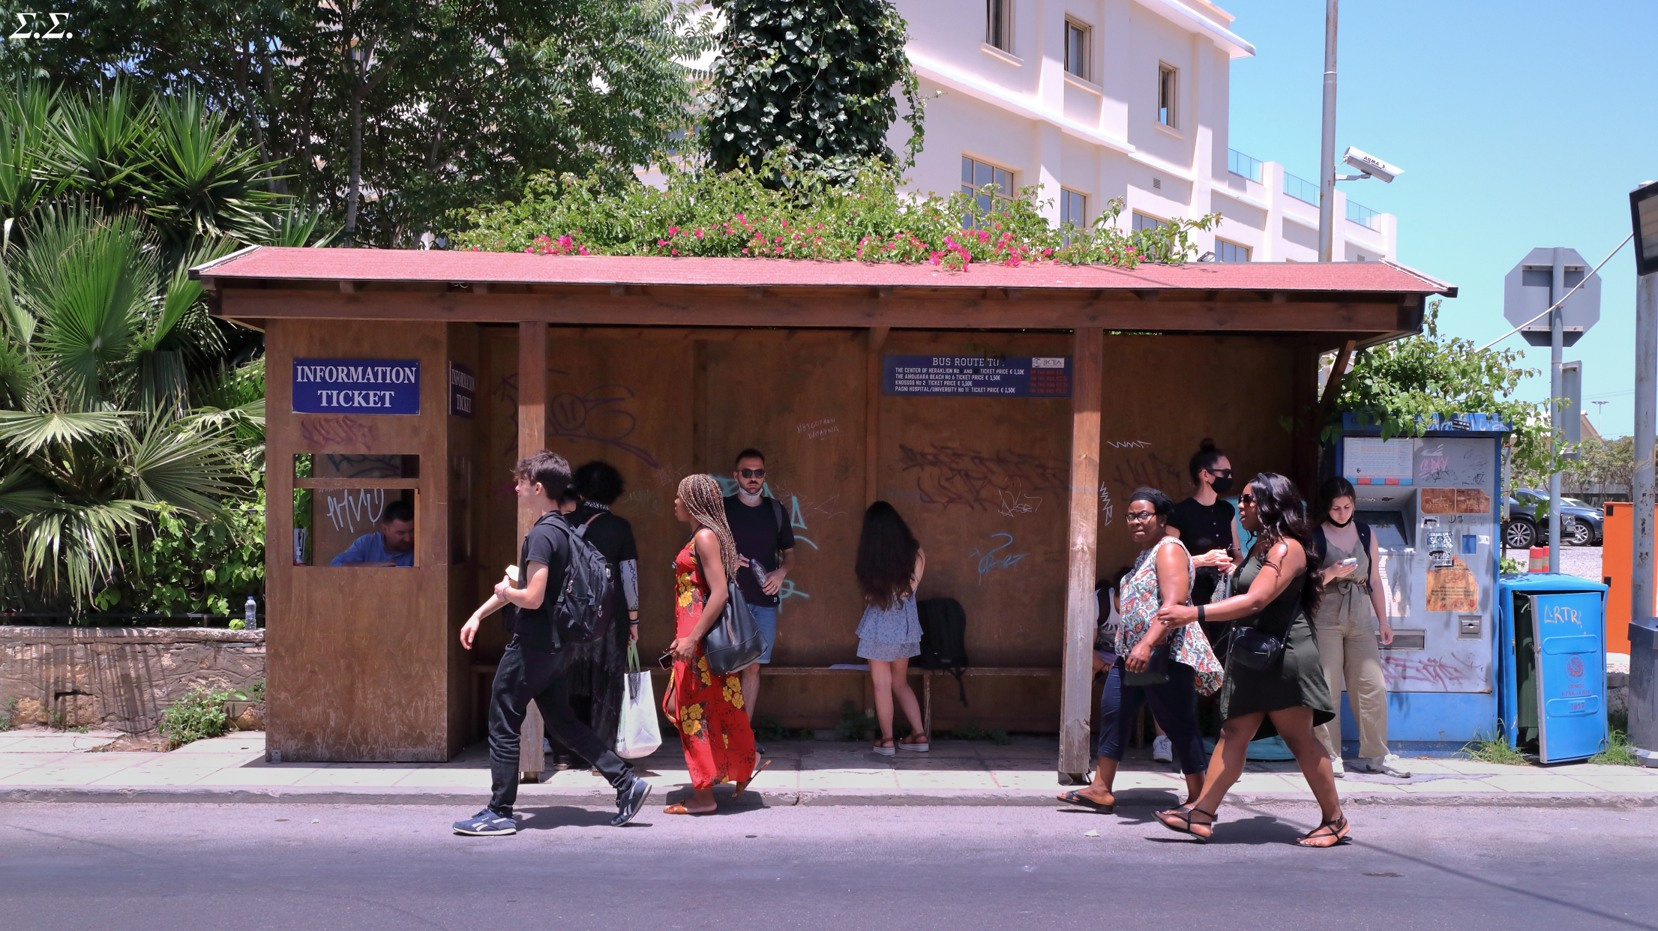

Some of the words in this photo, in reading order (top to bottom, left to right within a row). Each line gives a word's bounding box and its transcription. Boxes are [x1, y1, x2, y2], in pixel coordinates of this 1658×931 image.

[932, 358, 951, 366] BUS
[954, 358, 984, 366] ROUTE
[296, 366, 416, 384] INFORMATION
[318, 390, 394, 408] TICKET
